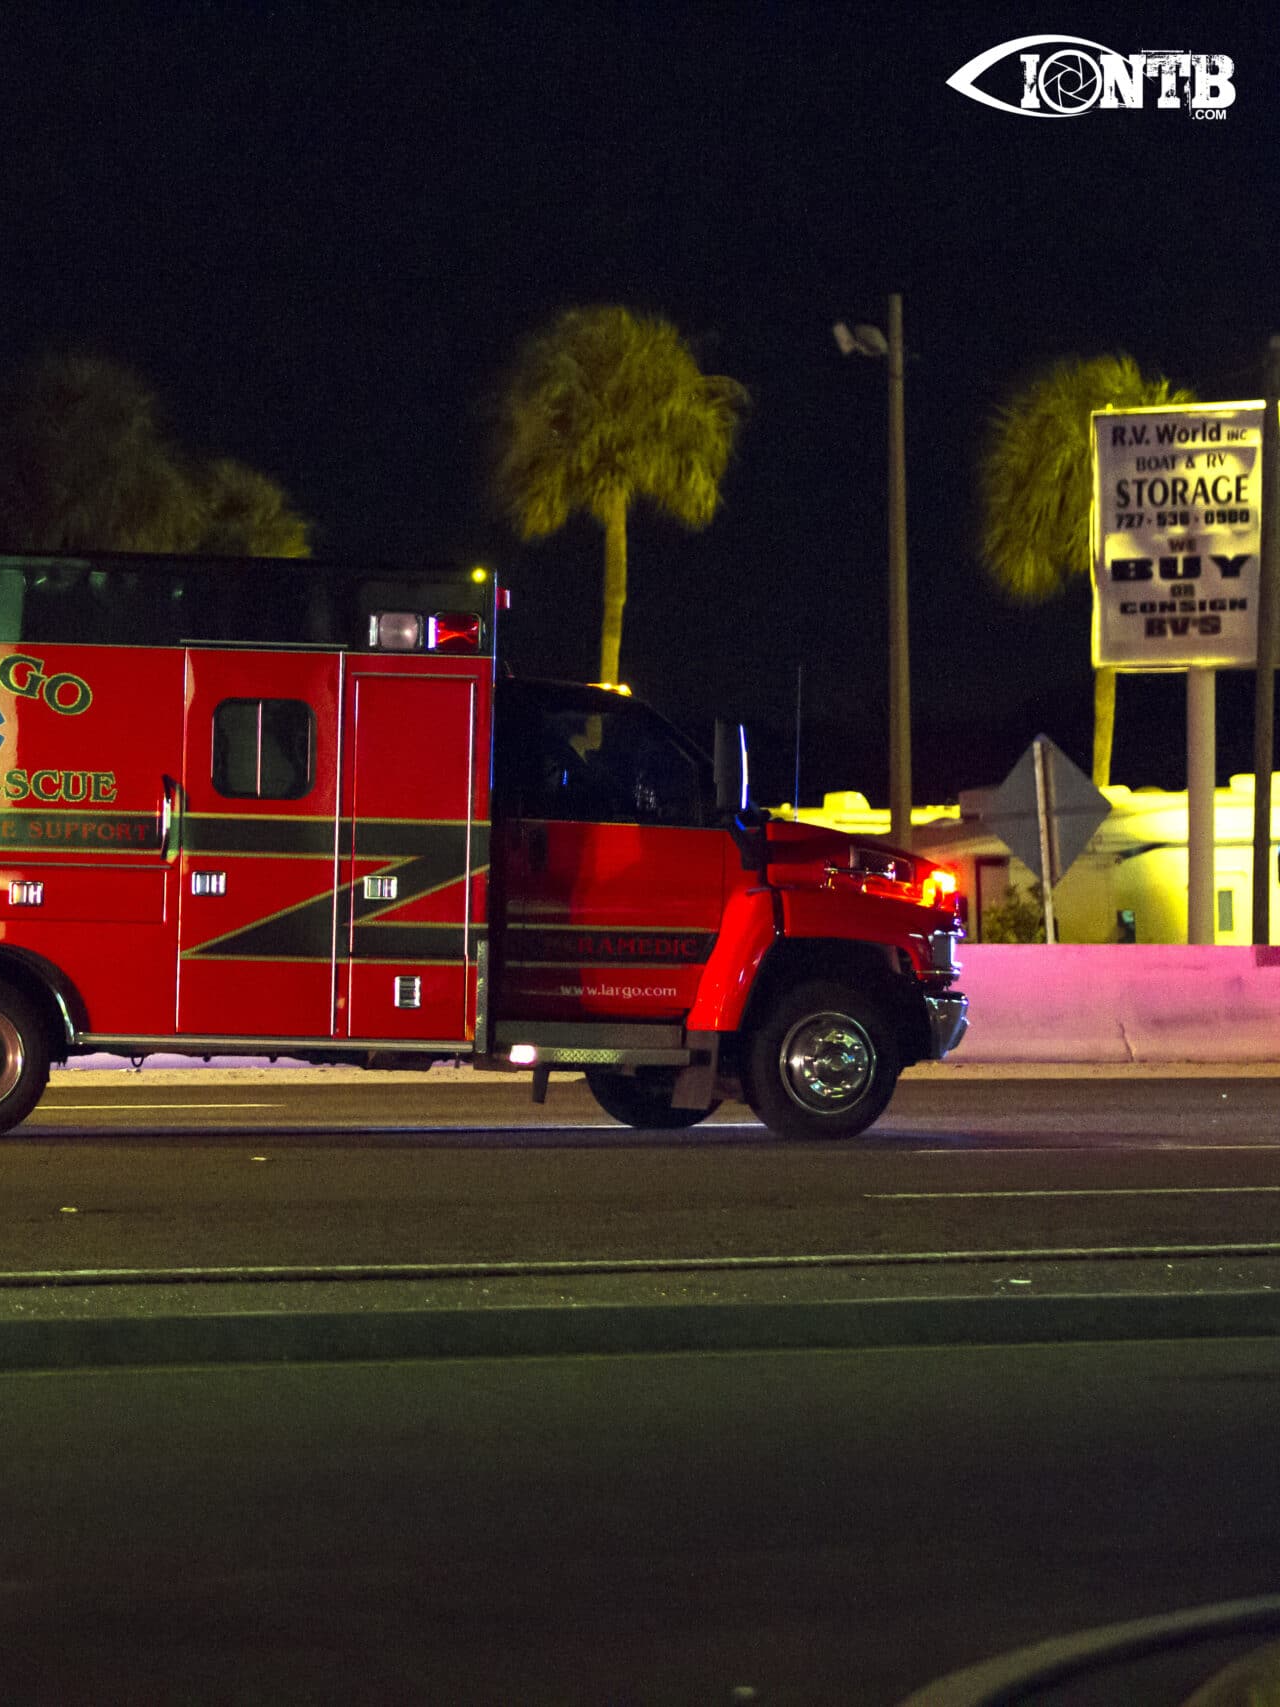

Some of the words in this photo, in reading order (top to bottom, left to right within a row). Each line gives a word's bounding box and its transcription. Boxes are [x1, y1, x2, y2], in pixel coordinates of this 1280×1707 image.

[1112, 424, 1150, 446] R.V.
[1156, 422, 1221, 444] World
[1136, 454, 1177, 472] BOAT
[1206, 453, 1227, 467] RV
[1116, 474, 1250, 508] STORAGE
[1111, 554, 1252, 581] BUY
[1120, 598, 1248, 614] CONSIGN
[28, 820, 150, 841] SUPPORT
[544, 936, 697, 957] RAMEDIC
[560, 983, 677, 999] www.largo.com
